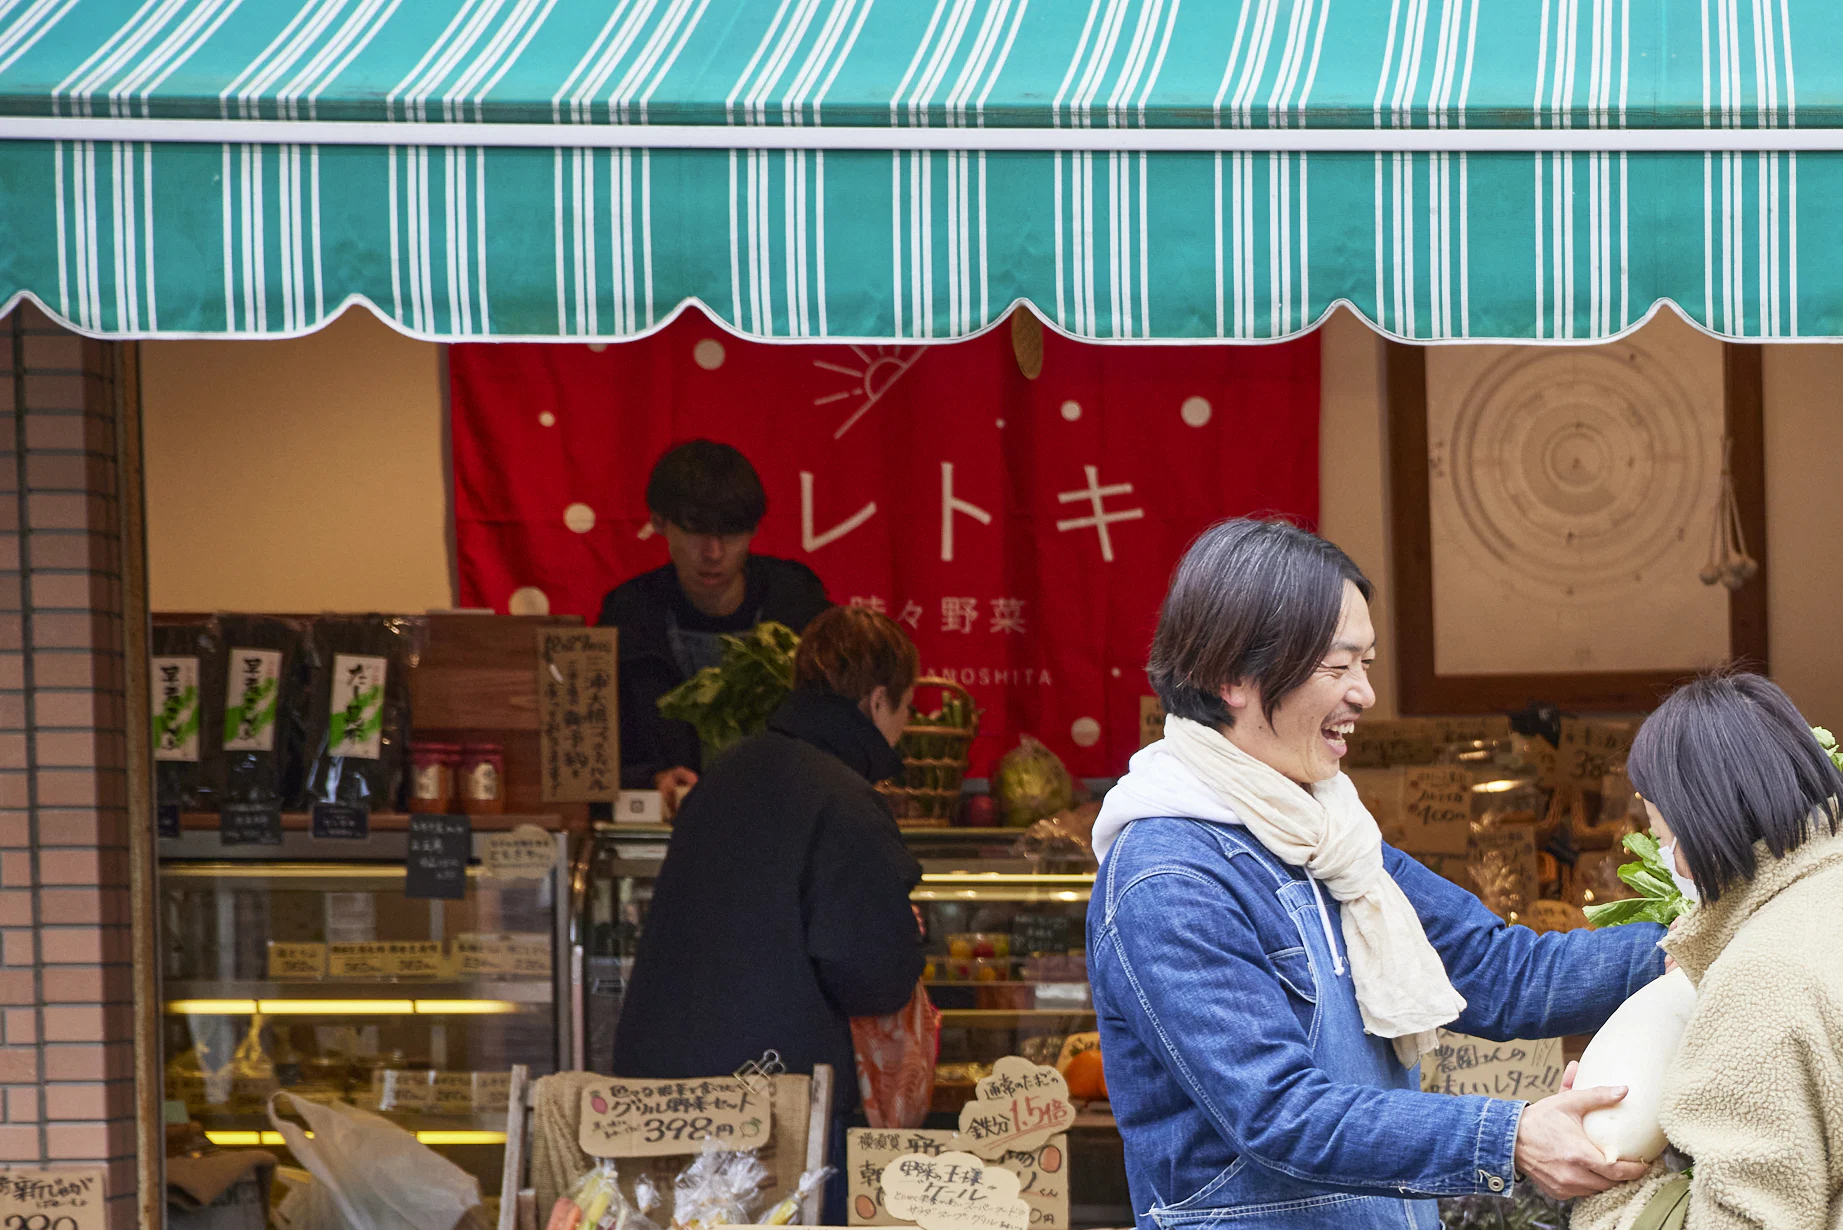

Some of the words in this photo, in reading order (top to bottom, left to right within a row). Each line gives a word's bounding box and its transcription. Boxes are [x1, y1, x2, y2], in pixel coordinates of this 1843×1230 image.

[637, 462, 1144, 562] レトキ
[851, 595, 1026, 634] 々野菜
[984, 1071, 1059, 1100] 通常のたまごの
[1424, 1066, 1559, 1096] 味しいレタス!!
[611, 1092, 755, 1118] グリル野菜セット
[644, 1116, 734, 1143] 398円
[899, 1160, 984, 1187] 野菜の王様
